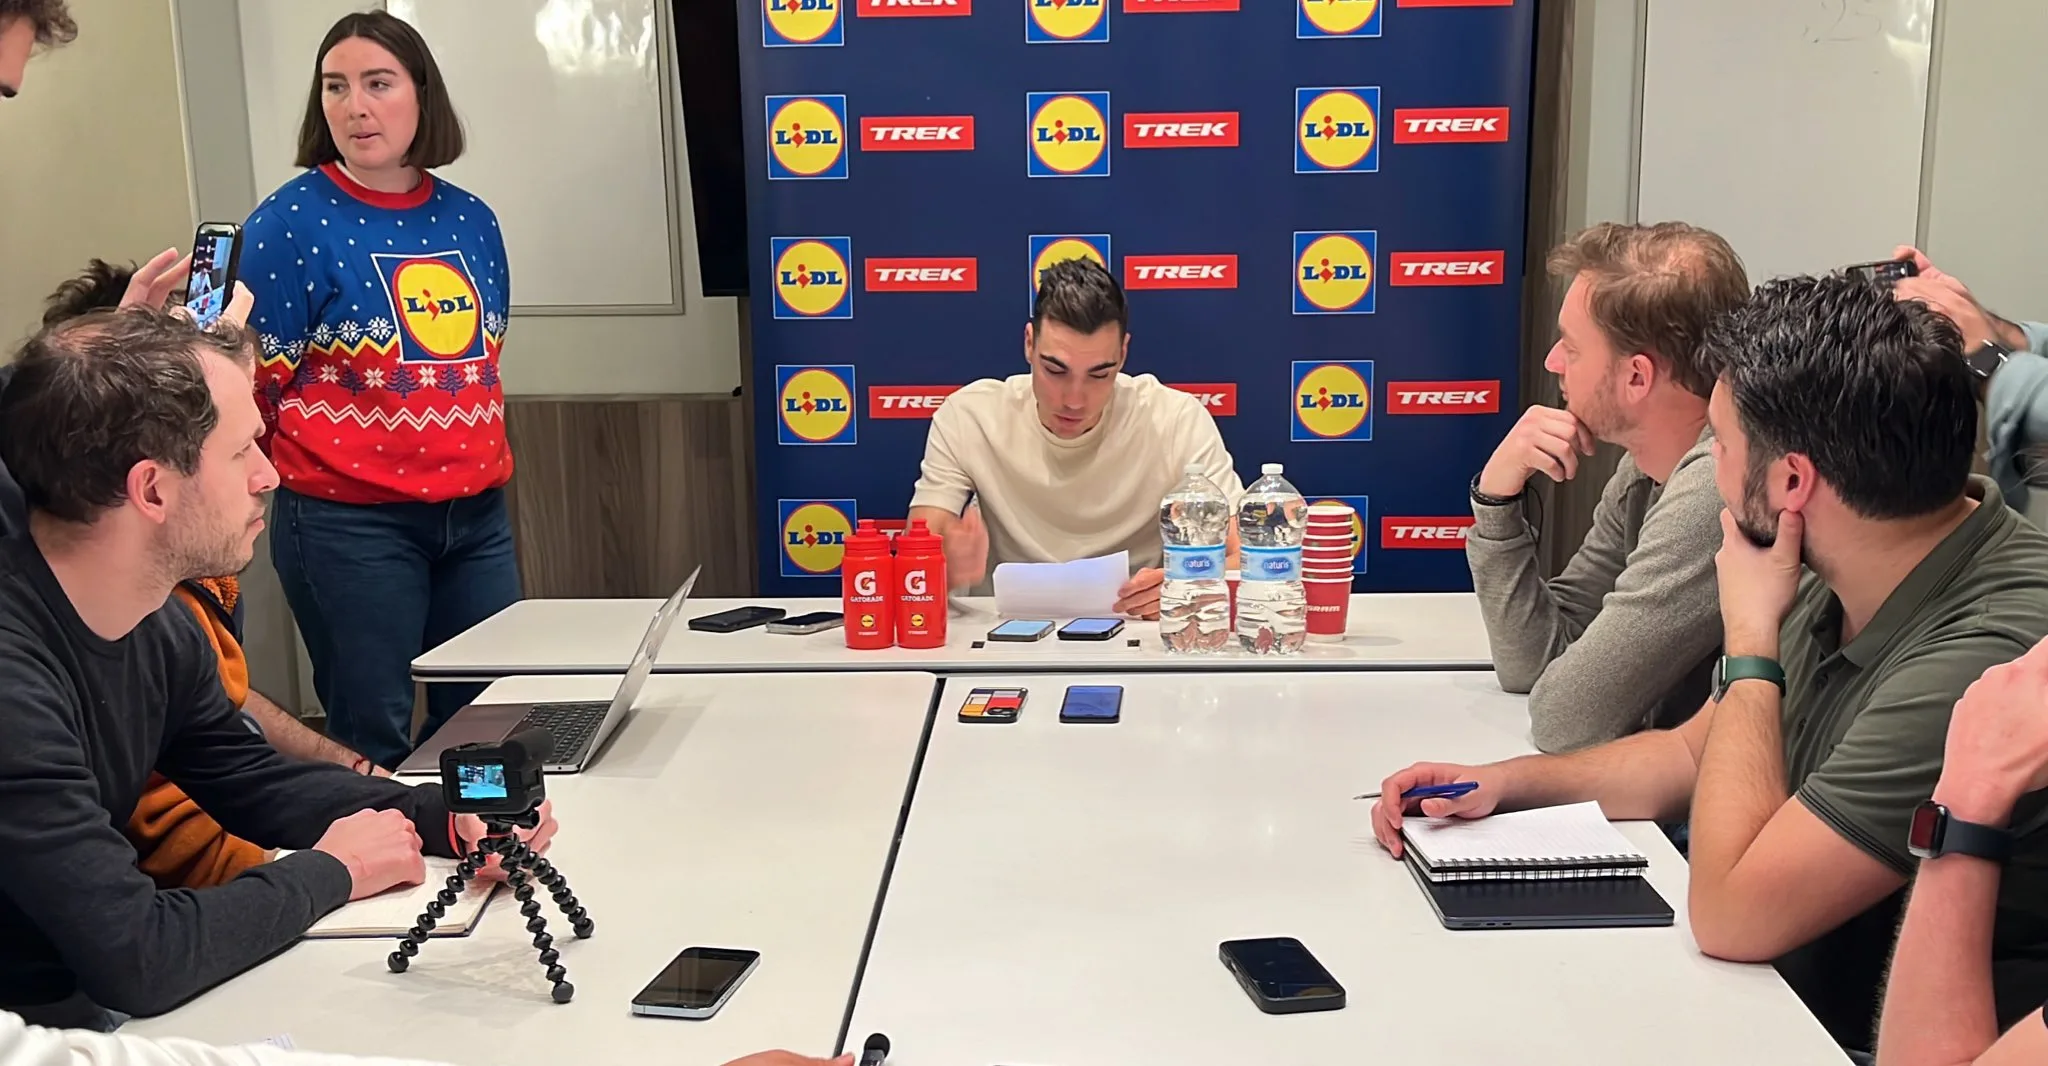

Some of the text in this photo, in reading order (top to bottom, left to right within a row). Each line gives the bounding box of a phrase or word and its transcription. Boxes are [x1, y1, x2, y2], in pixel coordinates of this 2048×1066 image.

[1133, 123, 1229, 137] TREK
[1403, 117, 1499, 132] TREK
[870, 126, 964, 140] TREK
[874, 268, 967, 281] TREK
[1133, 265, 1228, 279] TREK
[1399, 262, 1495, 276] TREK
[878, 395, 947, 408] TRE
[1396, 390, 1491, 404] TREK
[854, 571, 876, 596] G
[905, 570, 926, 595] G
